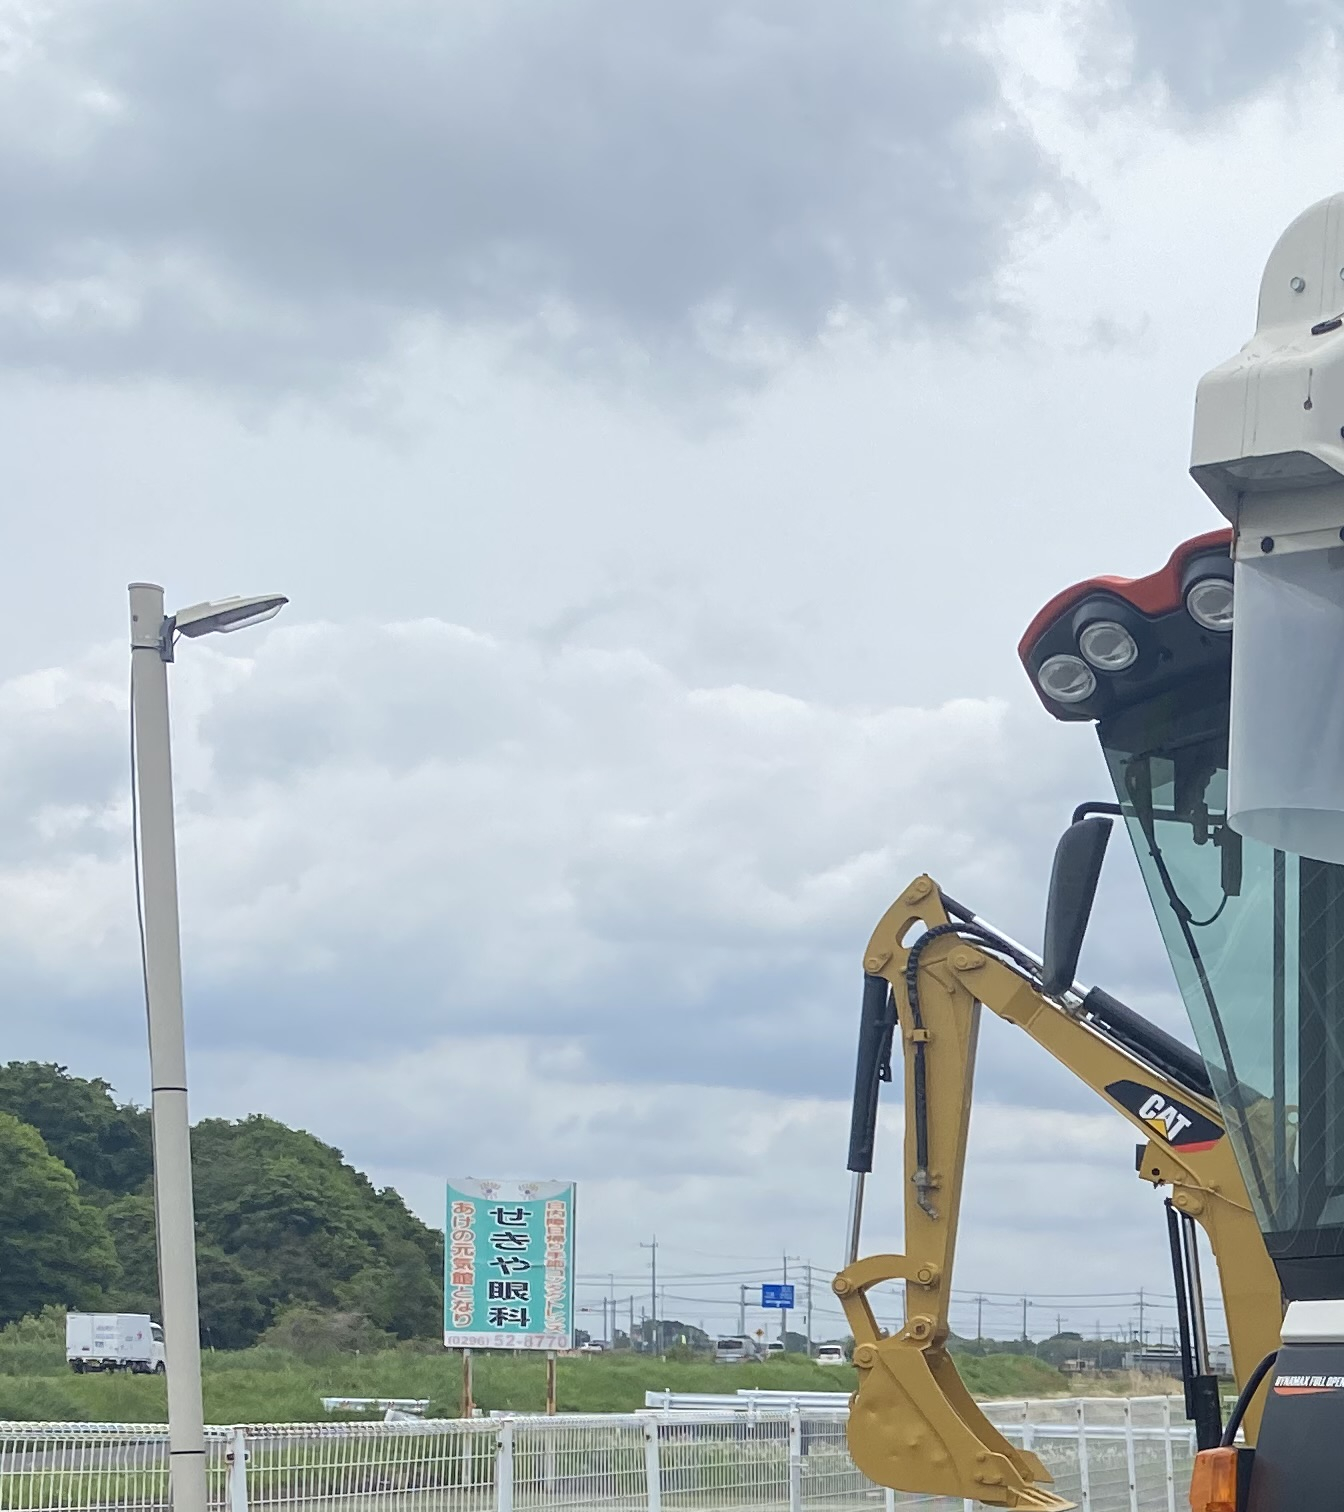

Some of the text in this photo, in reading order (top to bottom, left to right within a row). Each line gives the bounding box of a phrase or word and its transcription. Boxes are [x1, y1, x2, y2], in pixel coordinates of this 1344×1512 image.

[1139, 1094, 1192, 1141] CAT
[451, 1201, 476, 1328] あけの元気館となり
[488, 1206, 533, 1328] せきや眼科
[494, 1334, 568, 1348] 52-8770
